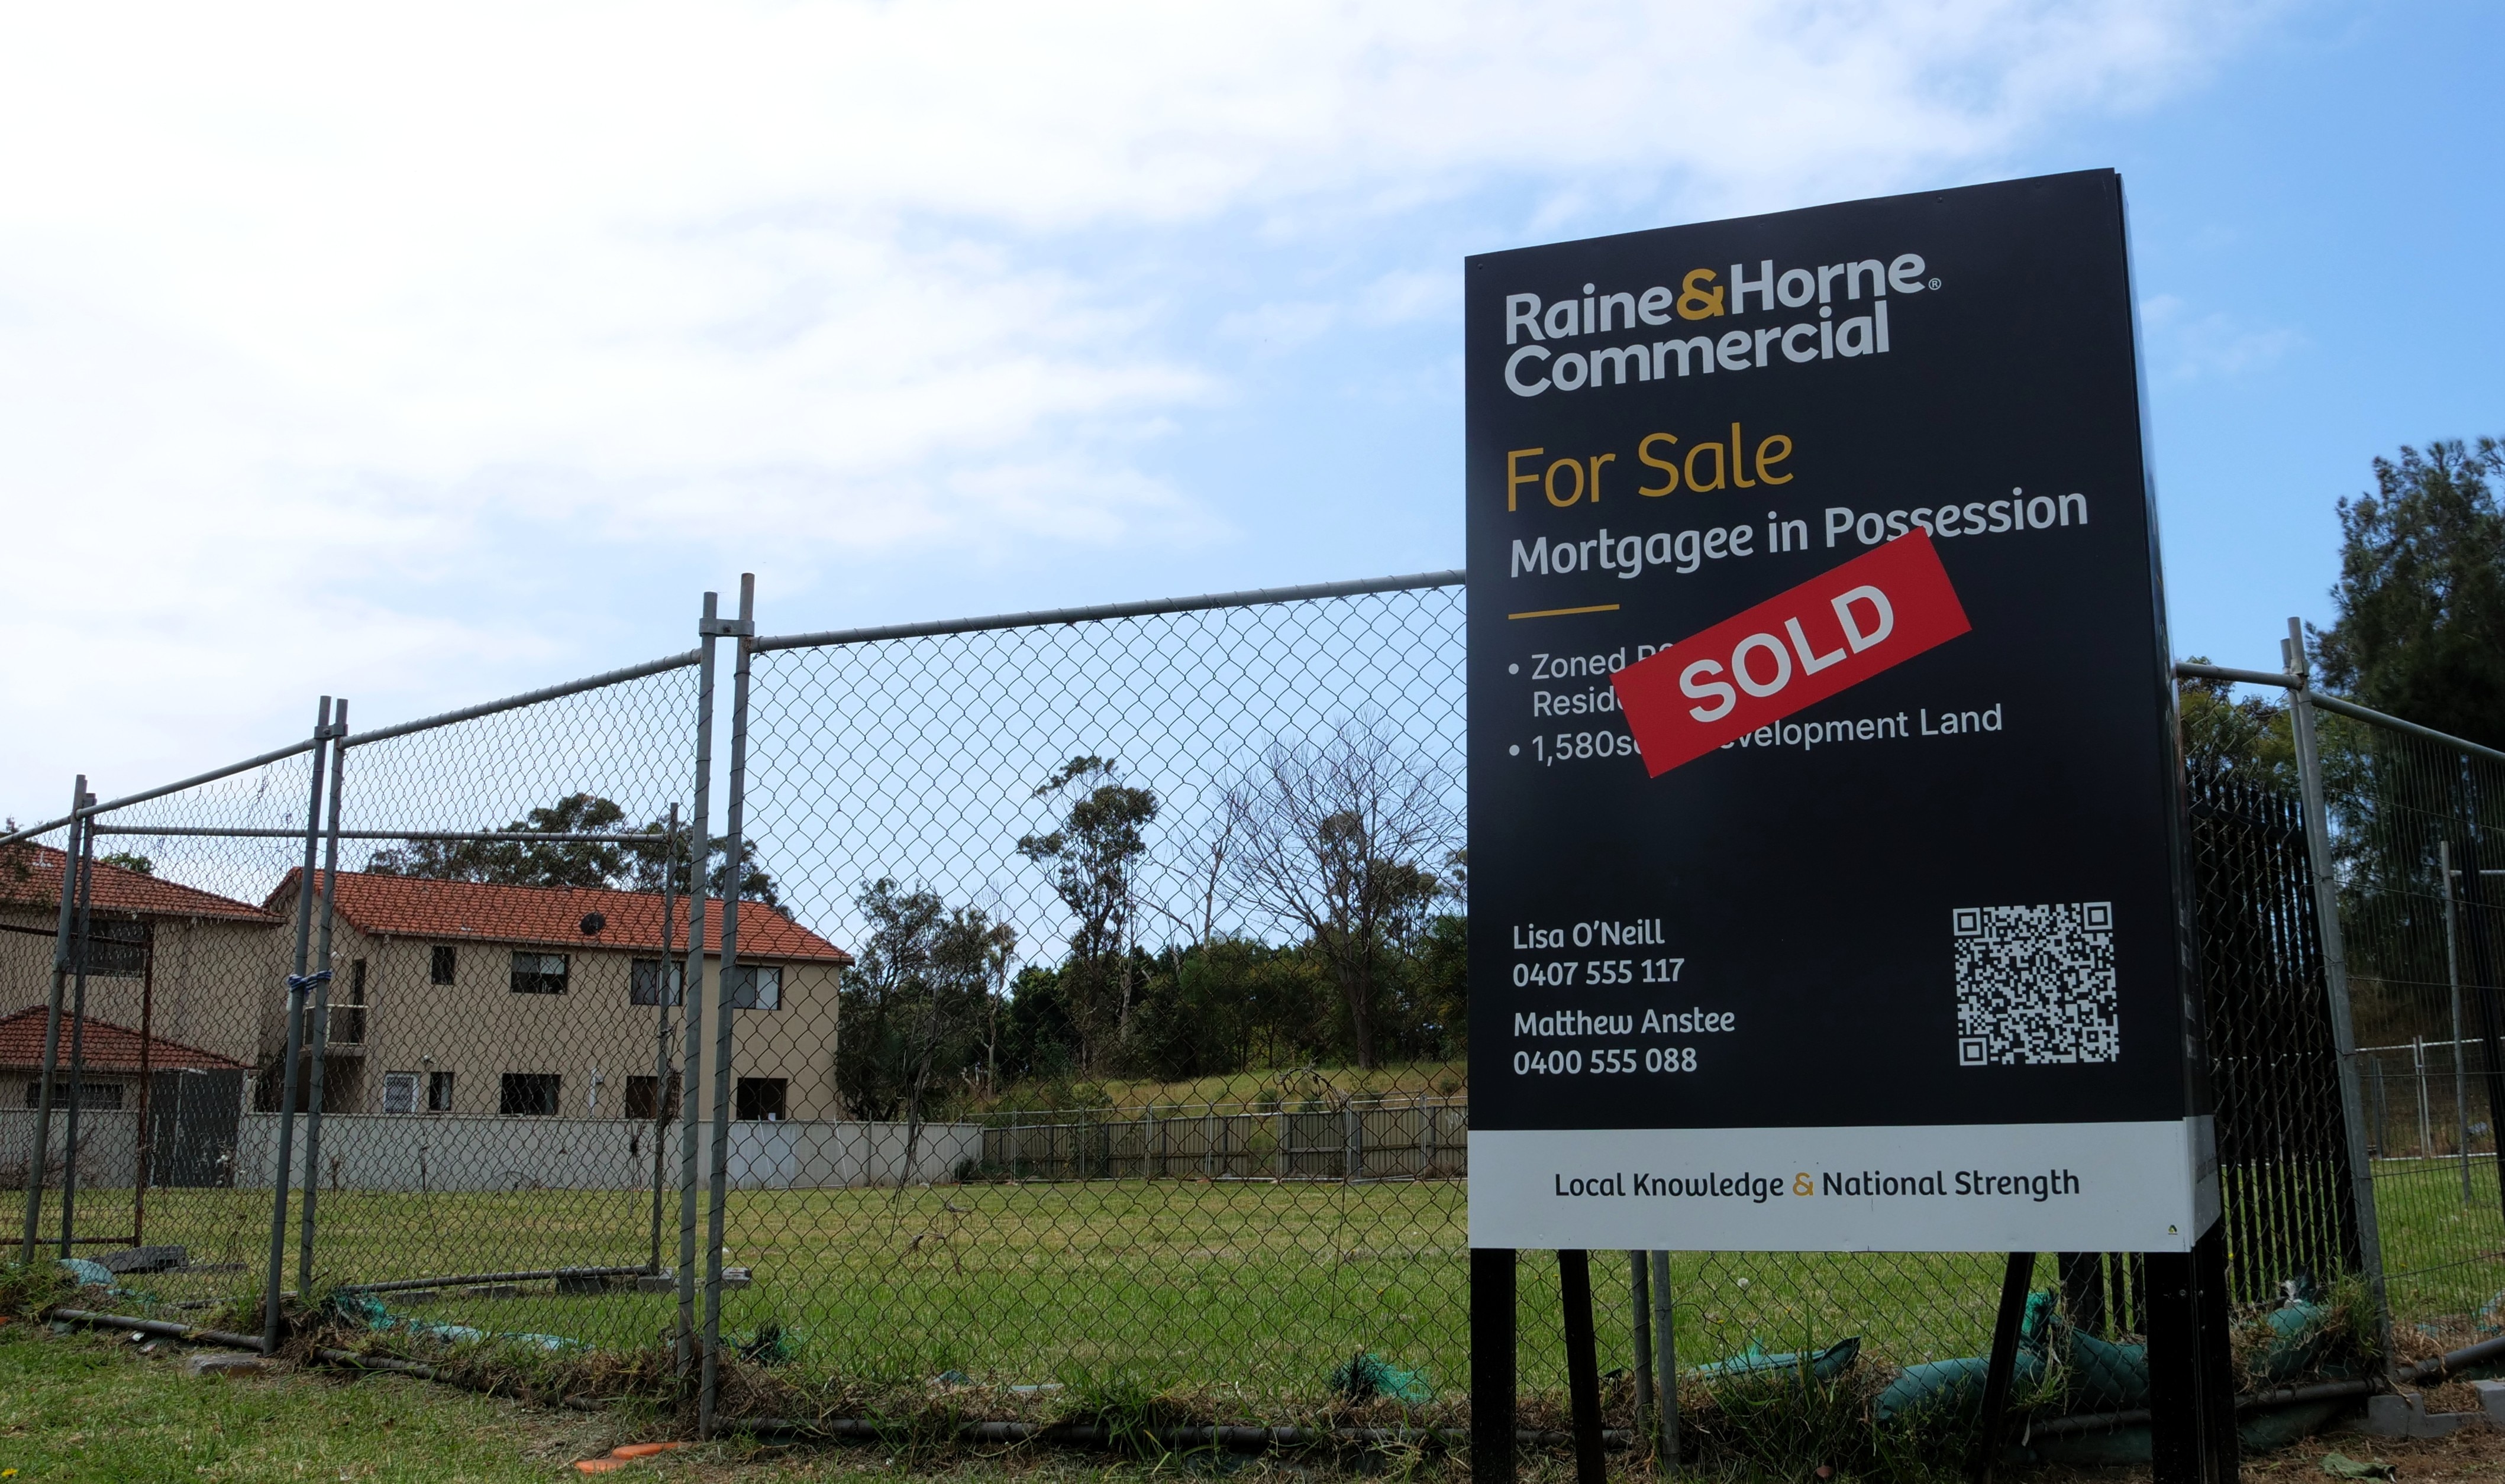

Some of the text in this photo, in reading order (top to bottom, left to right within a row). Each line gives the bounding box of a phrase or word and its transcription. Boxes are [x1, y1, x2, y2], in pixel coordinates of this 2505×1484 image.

[1505, 300, 1889, 397] Commercial
[1509, 422, 1793, 510] For Sale
[1511, 487, 2087, 578] Mortgagee in Possession
[1532, 647, 1625, 680] Zoned
[1680, 585, 1893, 722] SOLD
[1534, 686, 1623, 717] Resid
[1720, 712, 1909, 750] velopment
[1921, 703, 2002, 735] Land
[1514, 919, 1665, 949] Lisa O'Neill
[1513, 958, 1684, 987] 0407 555 117
[1515, 1007, 1735, 1036] Matthew Anstee
[1514, 1047, 1697, 1075] 0400 555 088
[1555, 1169, 2079, 1203] Local Knowledge & National Strength
